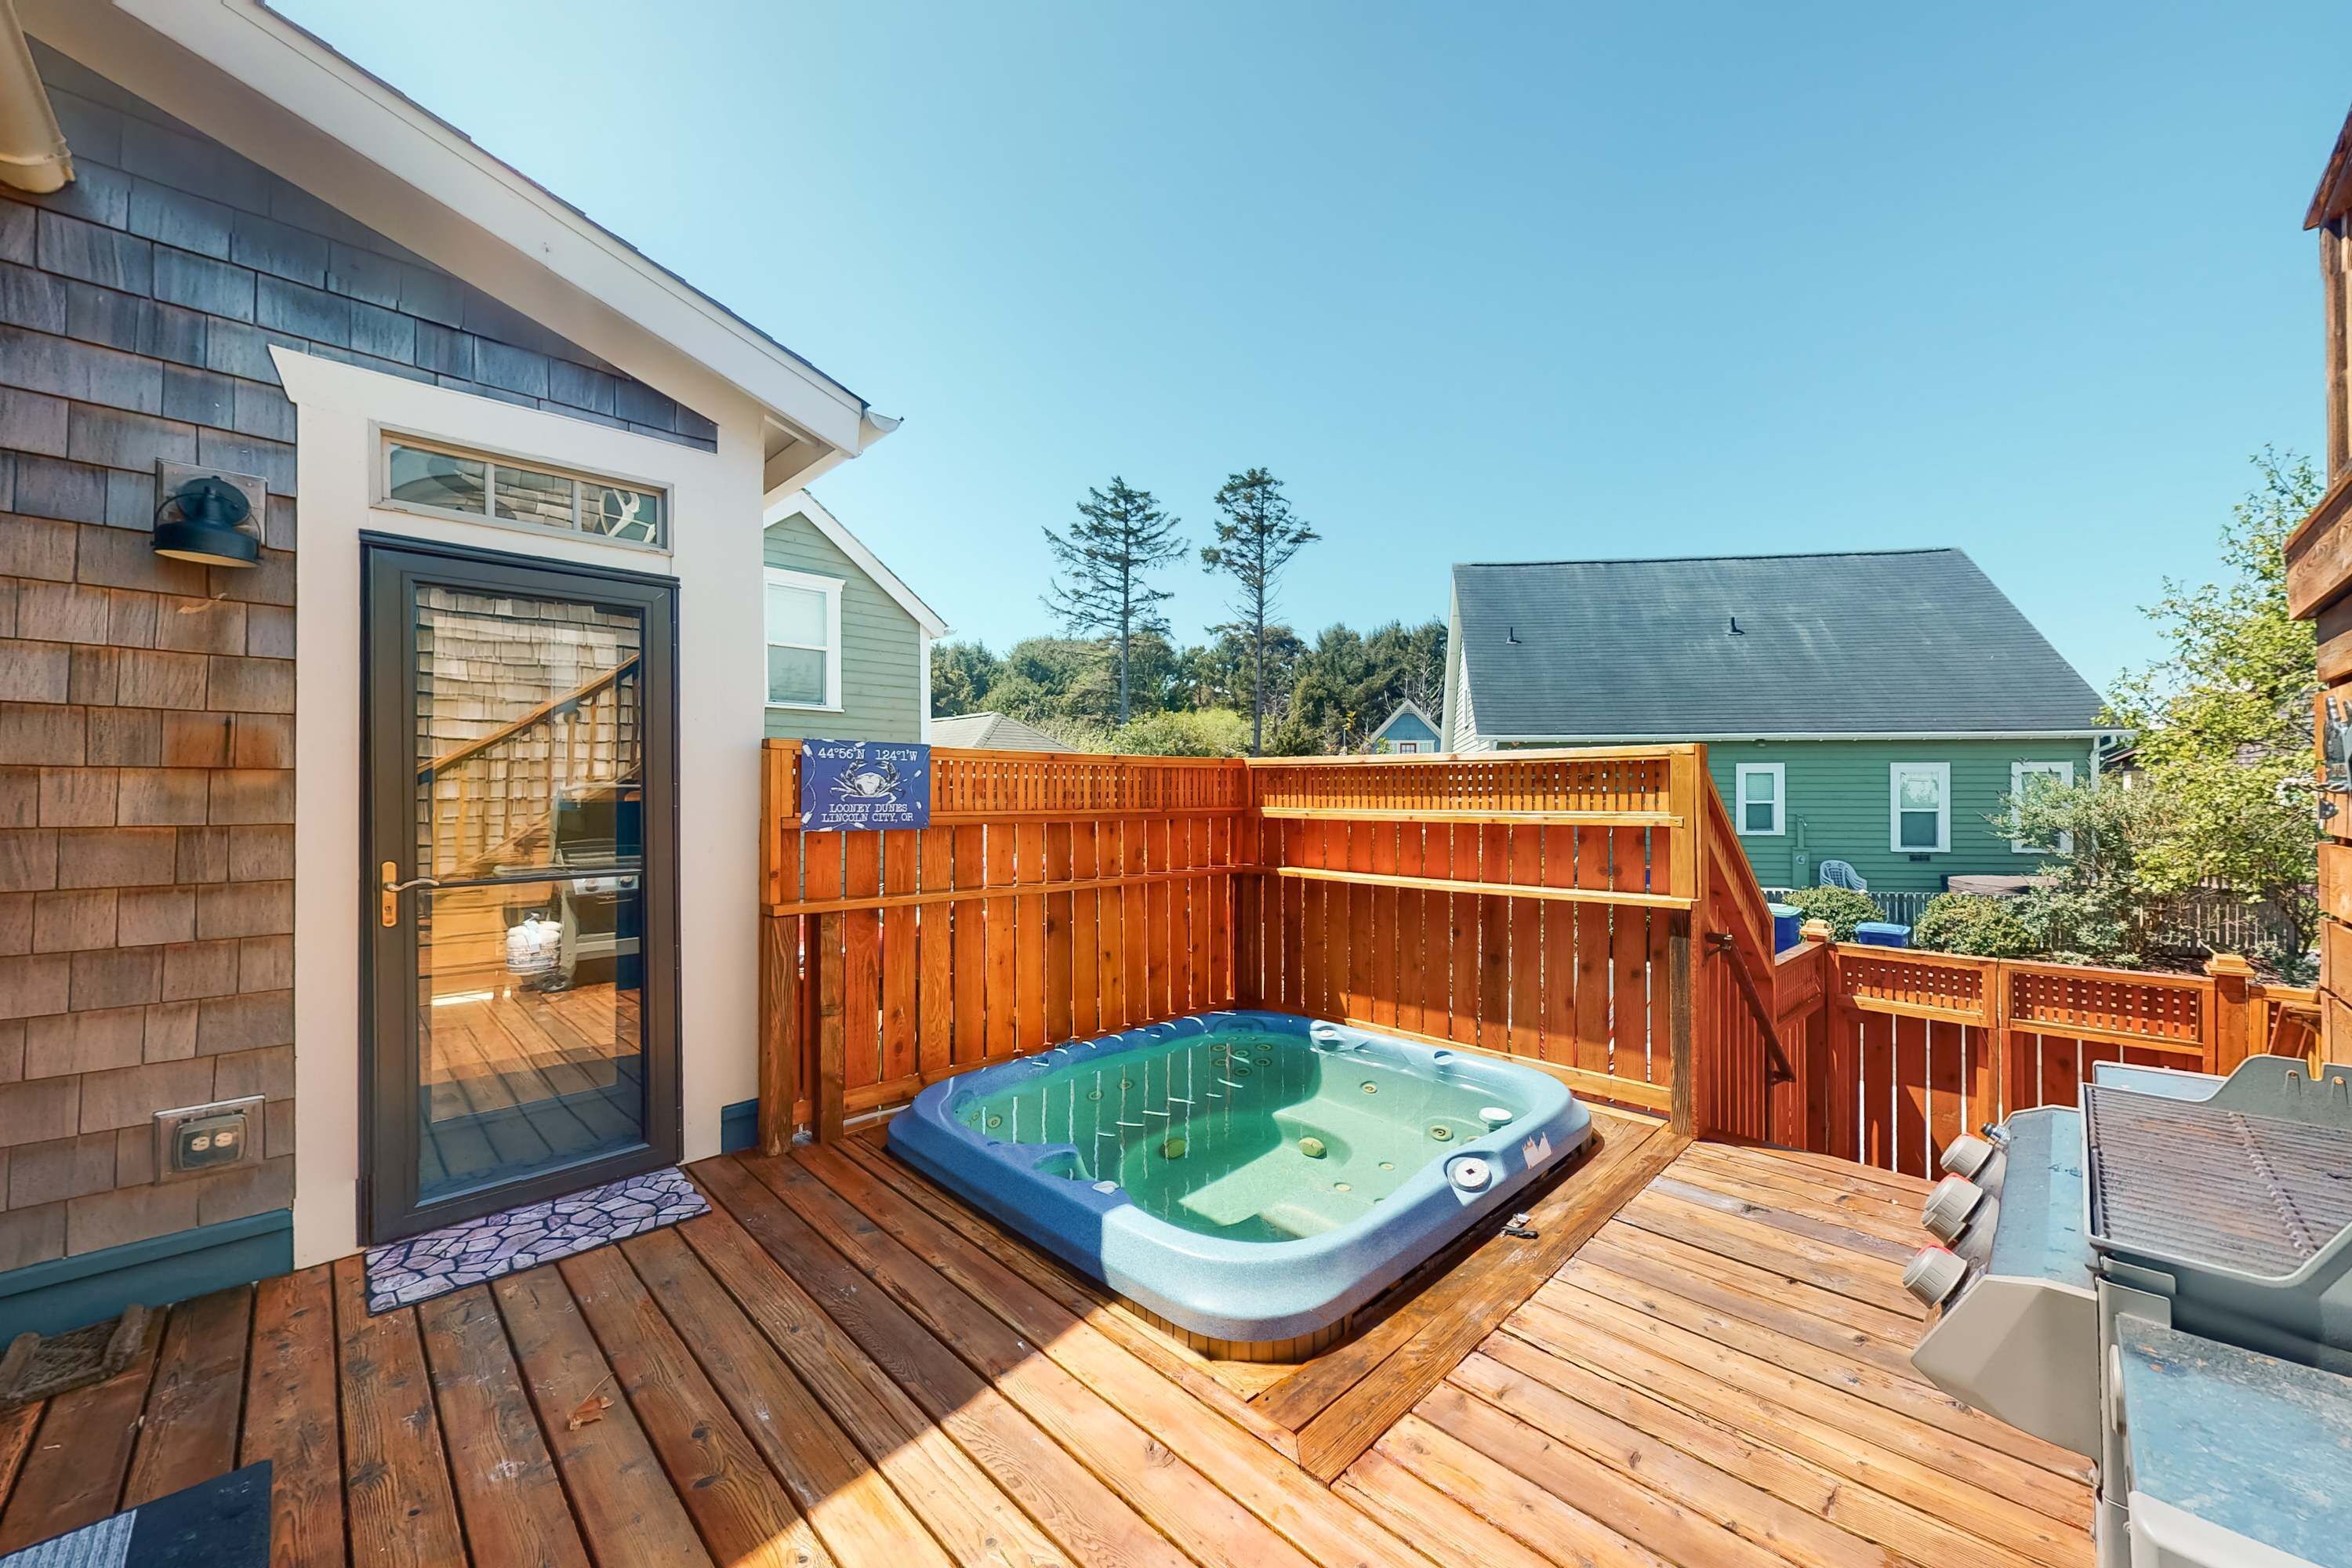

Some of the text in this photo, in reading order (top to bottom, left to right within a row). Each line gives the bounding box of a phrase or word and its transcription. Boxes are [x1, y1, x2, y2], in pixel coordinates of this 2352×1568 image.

[829, 804, 908, 813] LOONEY DUNES
[821, 813, 914, 823] LINCOLN CITY, OR
